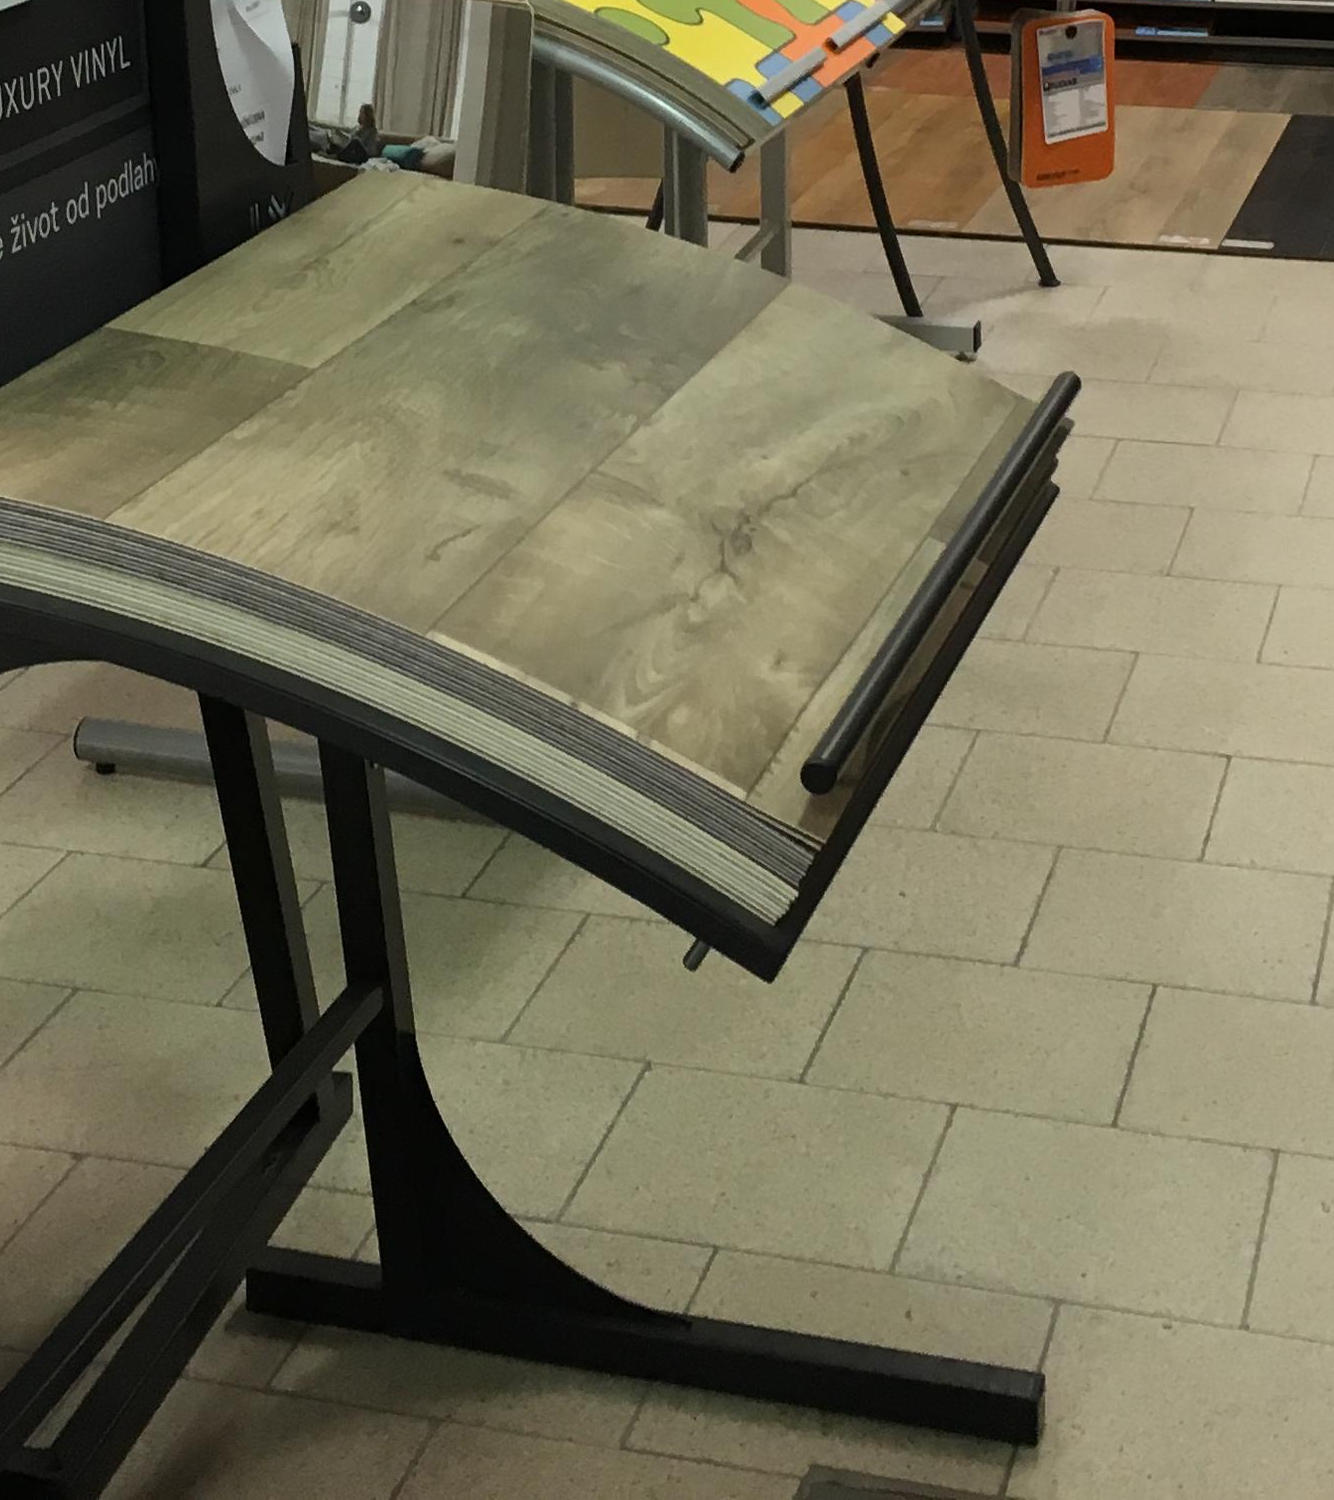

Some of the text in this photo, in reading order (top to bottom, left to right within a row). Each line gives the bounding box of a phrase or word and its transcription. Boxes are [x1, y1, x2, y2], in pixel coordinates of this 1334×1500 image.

[70, 36, 132, 94] VINYL
[10, 202, 60, 254] život
[66, 182, 90, 224] od
